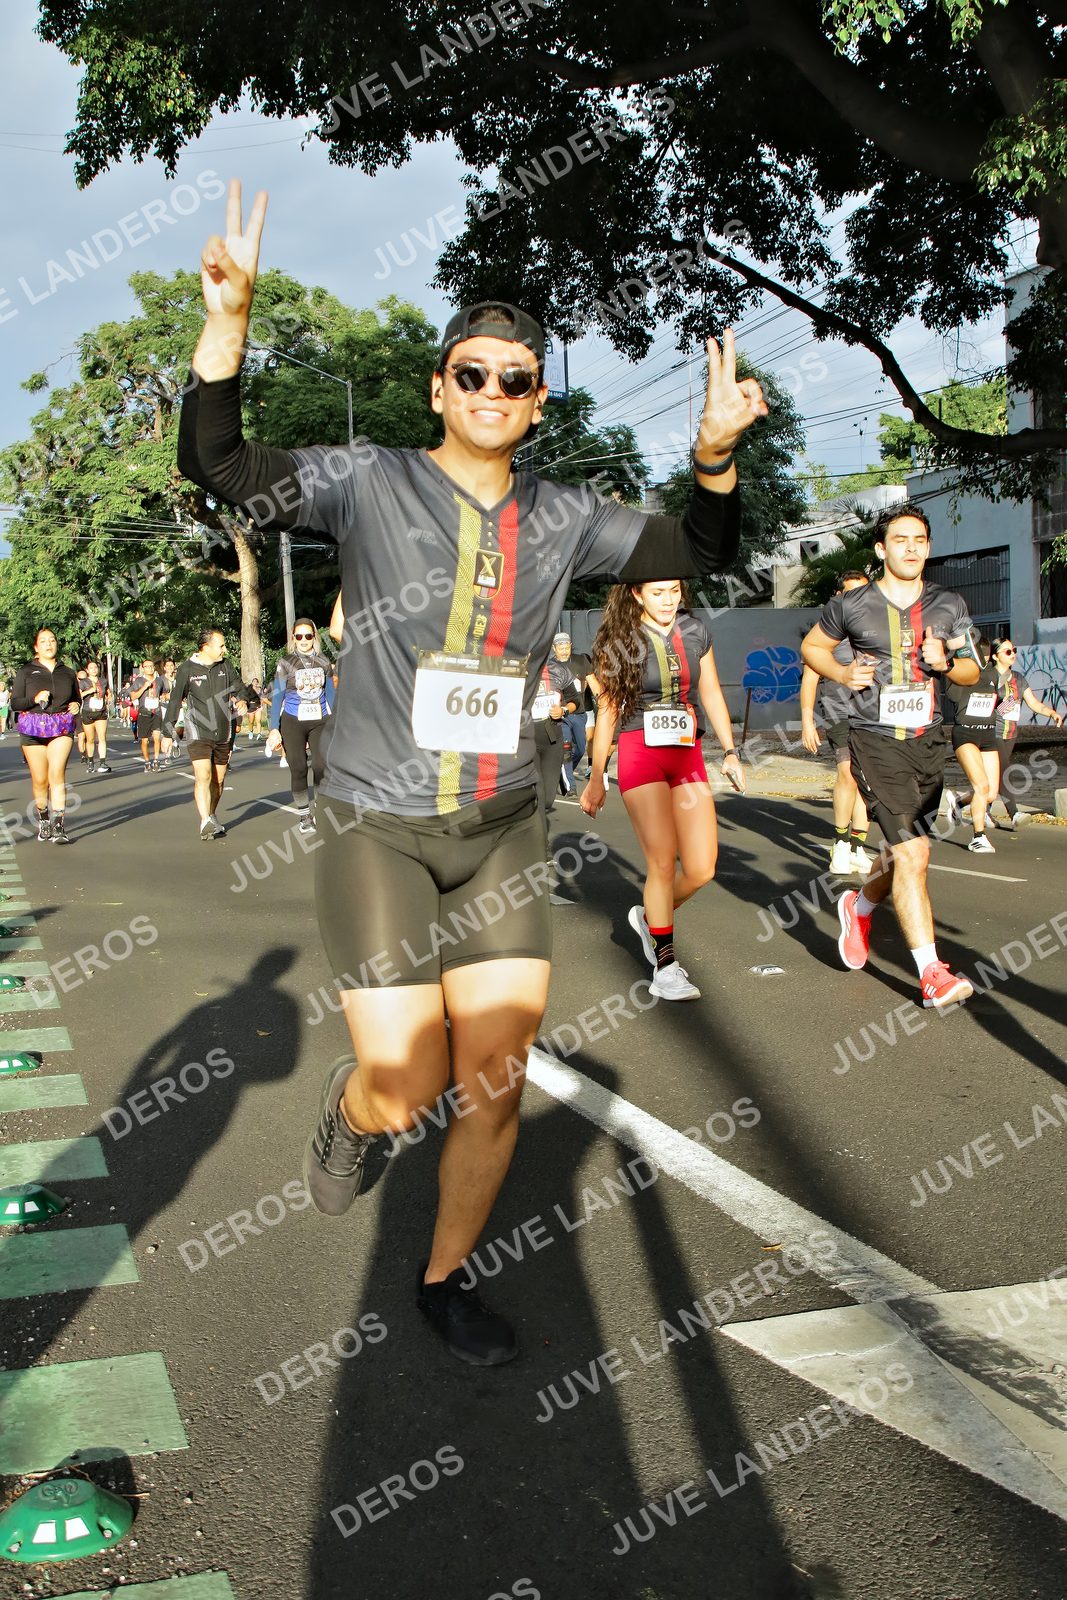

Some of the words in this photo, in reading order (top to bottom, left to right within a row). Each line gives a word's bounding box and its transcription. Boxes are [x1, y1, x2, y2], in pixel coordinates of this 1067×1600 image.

[446, 686, 499, 718] 666
[887, 697, 924, 714] 8046
[651, 715, 688, 730] 8856
